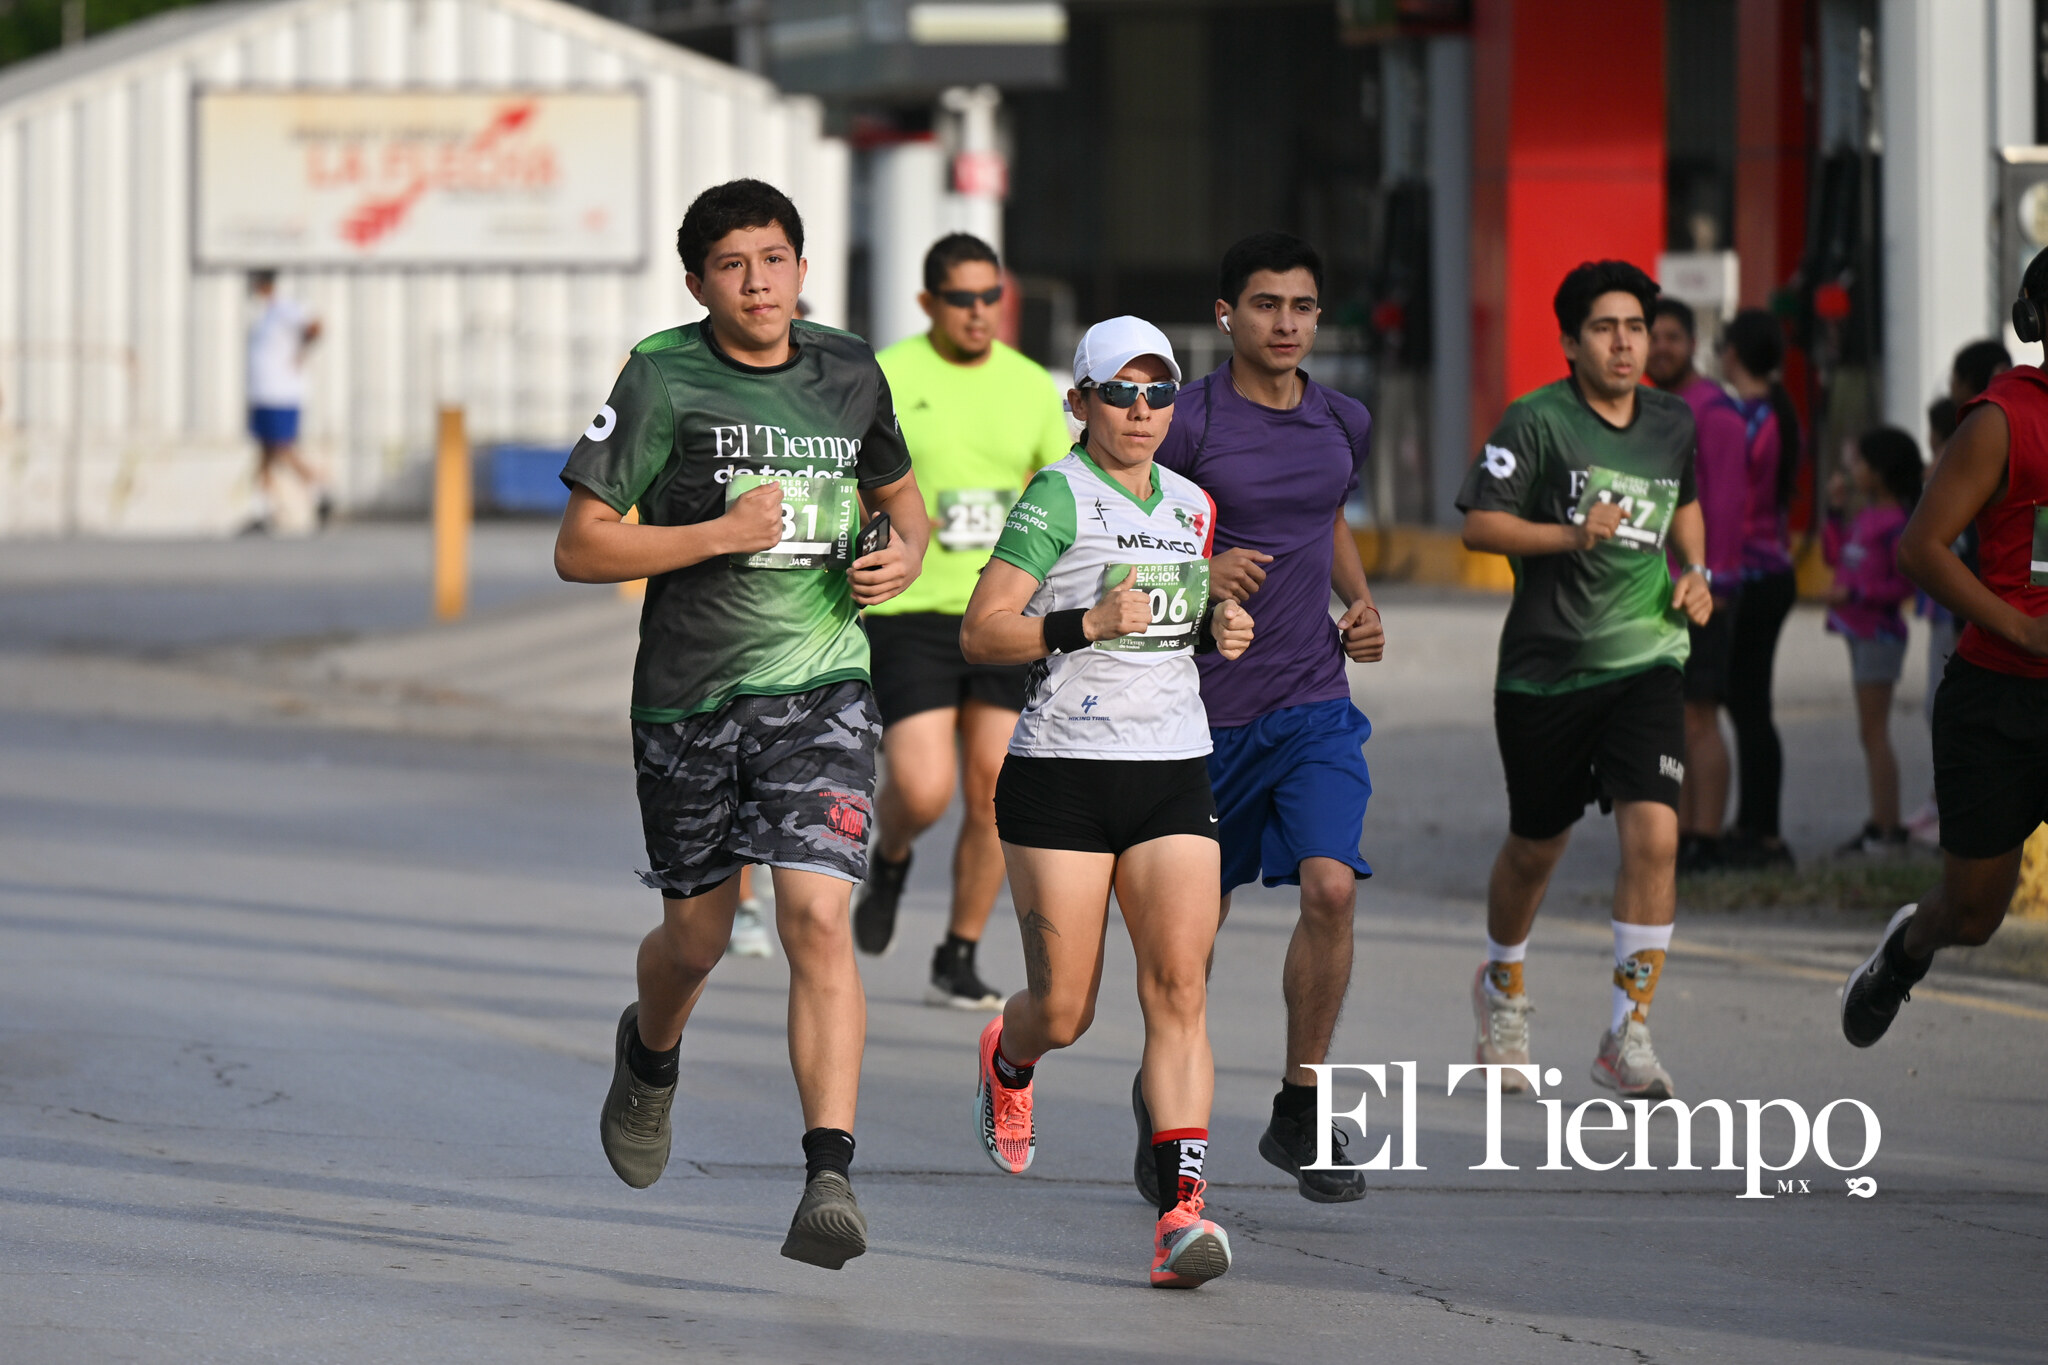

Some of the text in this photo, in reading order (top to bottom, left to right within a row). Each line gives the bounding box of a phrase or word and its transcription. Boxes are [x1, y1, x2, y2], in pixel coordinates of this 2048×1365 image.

[711, 424, 861, 468] El Tiempo
[840, 485, 853, 494] 181
[781, 503, 818, 541] 81
[837, 500, 851, 560] MEDALLA
[1028, 504, 1048, 518] KM
[1117, 531, 1197, 556] MÉXICO
[1192, 578, 1208, 635] MEDALLA
